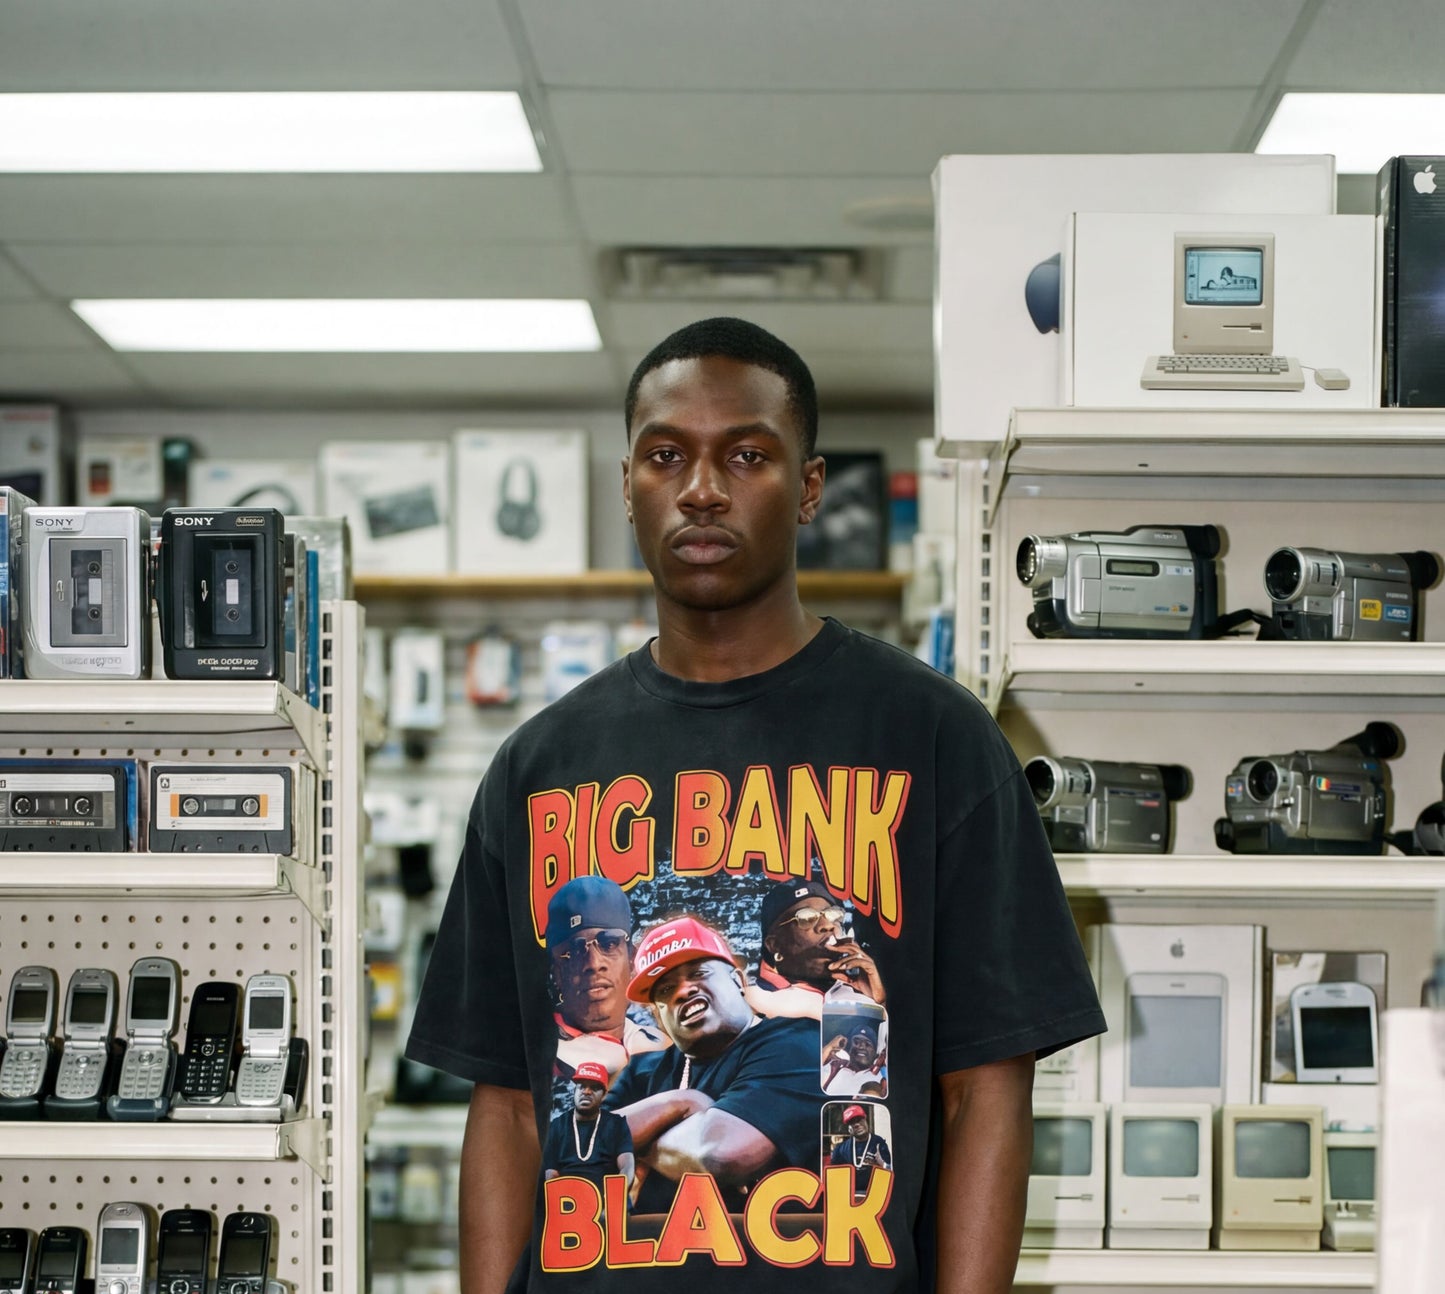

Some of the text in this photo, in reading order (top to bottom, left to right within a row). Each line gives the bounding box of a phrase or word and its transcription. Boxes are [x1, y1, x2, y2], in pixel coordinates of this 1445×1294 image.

[35, 518, 74, 527] SONY
[174, 517, 214, 526] SONY
[527, 763, 912, 949] BIG BANK
[541, 1164, 896, 1273] BLACK
